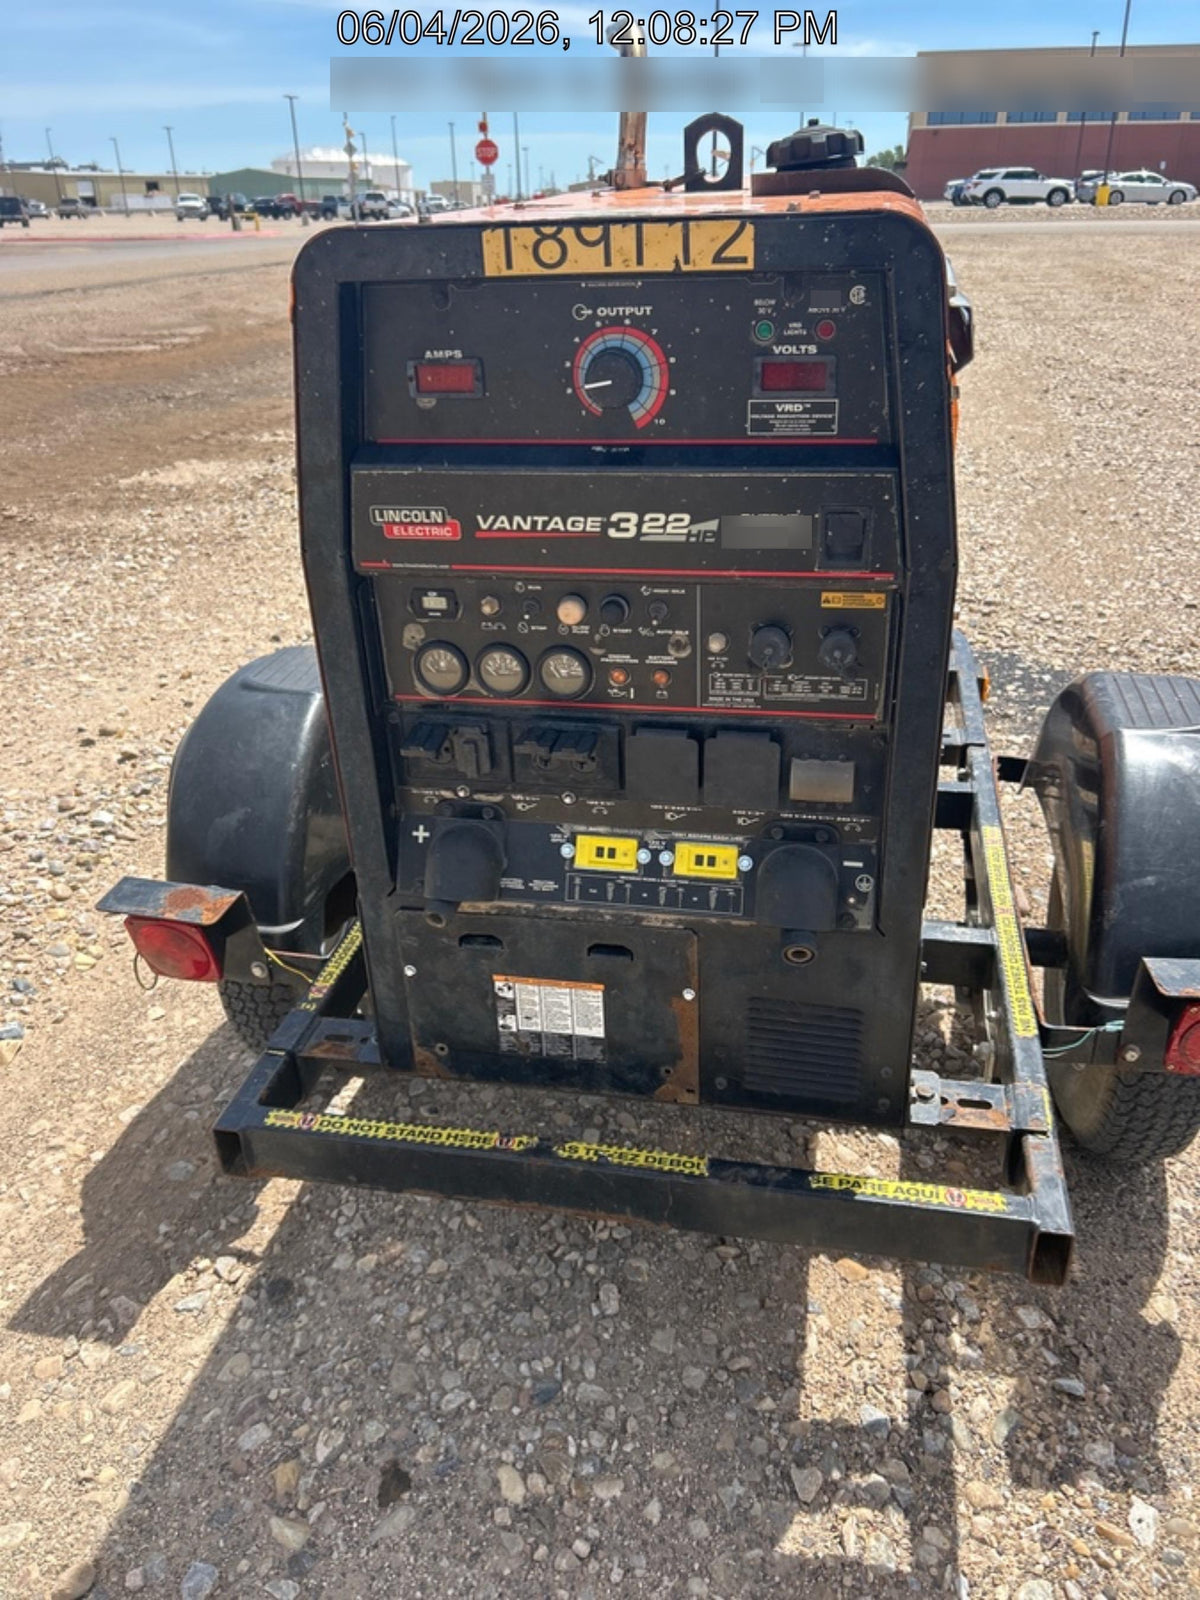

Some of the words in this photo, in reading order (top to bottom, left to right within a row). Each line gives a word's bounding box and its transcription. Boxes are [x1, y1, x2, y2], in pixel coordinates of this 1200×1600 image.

[477, 146, 497, 158] STOP
[596, 306, 653, 316] OUTPUT
[424, 349, 463, 359] AMPS
[773, 345, 818, 355] VOLTS
[374, 508, 444, 524] LINCOLN
[476, 514, 602, 532] VANTAGE
[607, 511, 692, 539] 322
[392, 526, 453, 537] ELECTRIC
[319, 1119, 344, 1130] DO
[346, 1121, 381, 1135] NOT
[386, 1126, 442, 1141] STAND
[446, 1131, 493, 1146] HERE
[838, 1178, 888, 1193] PARE
